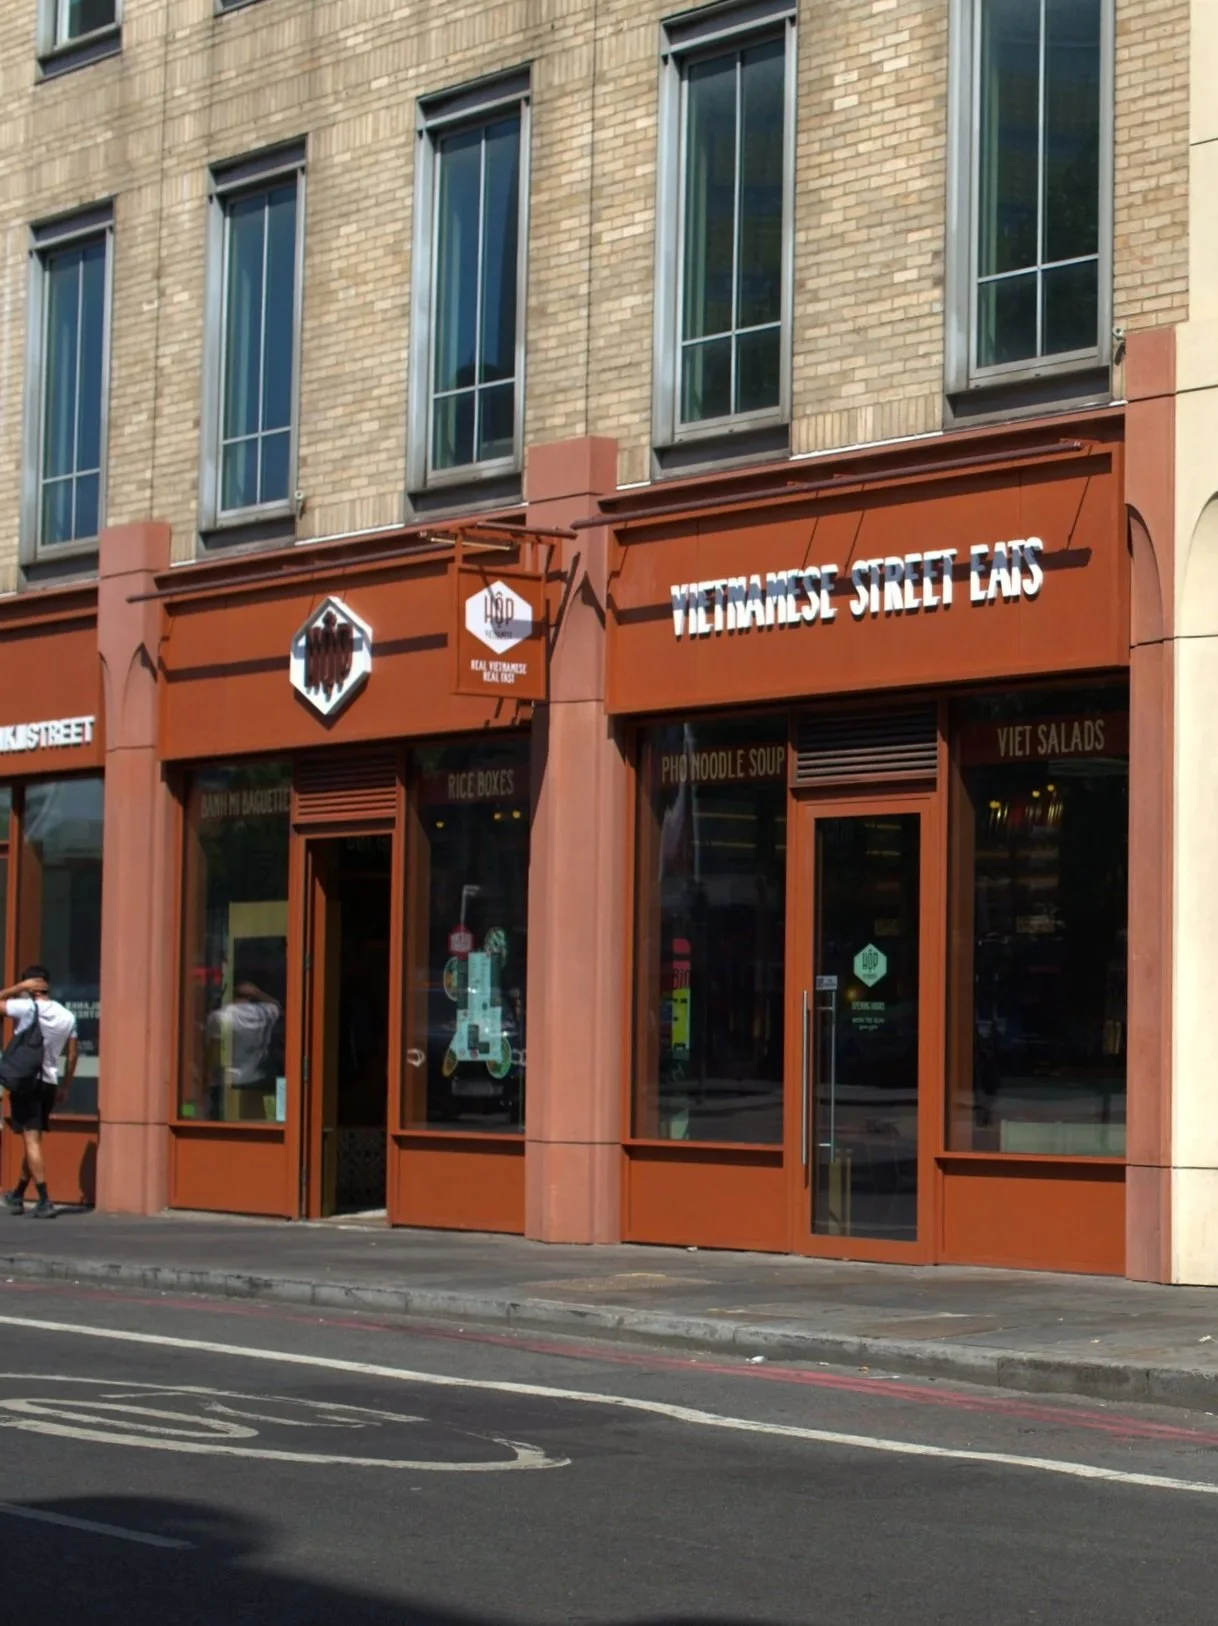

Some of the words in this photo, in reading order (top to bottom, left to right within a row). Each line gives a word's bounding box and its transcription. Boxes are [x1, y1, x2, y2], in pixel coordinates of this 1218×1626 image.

[671, 564, 838, 636] VIETNAMESE
[849, 549, 957, 616] STREET
[969, 537, 1044, 602] EATS
[471, 659, 486, 671] REAL
[489, 661, 527, 675] VIETNAMESE
[483, 671, 499, 683] REAL
[500, 672, 515, 684] FAST
[997, 725, 1032, 757] VIET
[1037, 719, 1105, 755] SALADS
[691, 749, 746, 781] NOODLE
[749, 746, 785, 777] SOUP
[447, 772, 475, 800] RICE
[477, 768, 514, 797] BOXES
